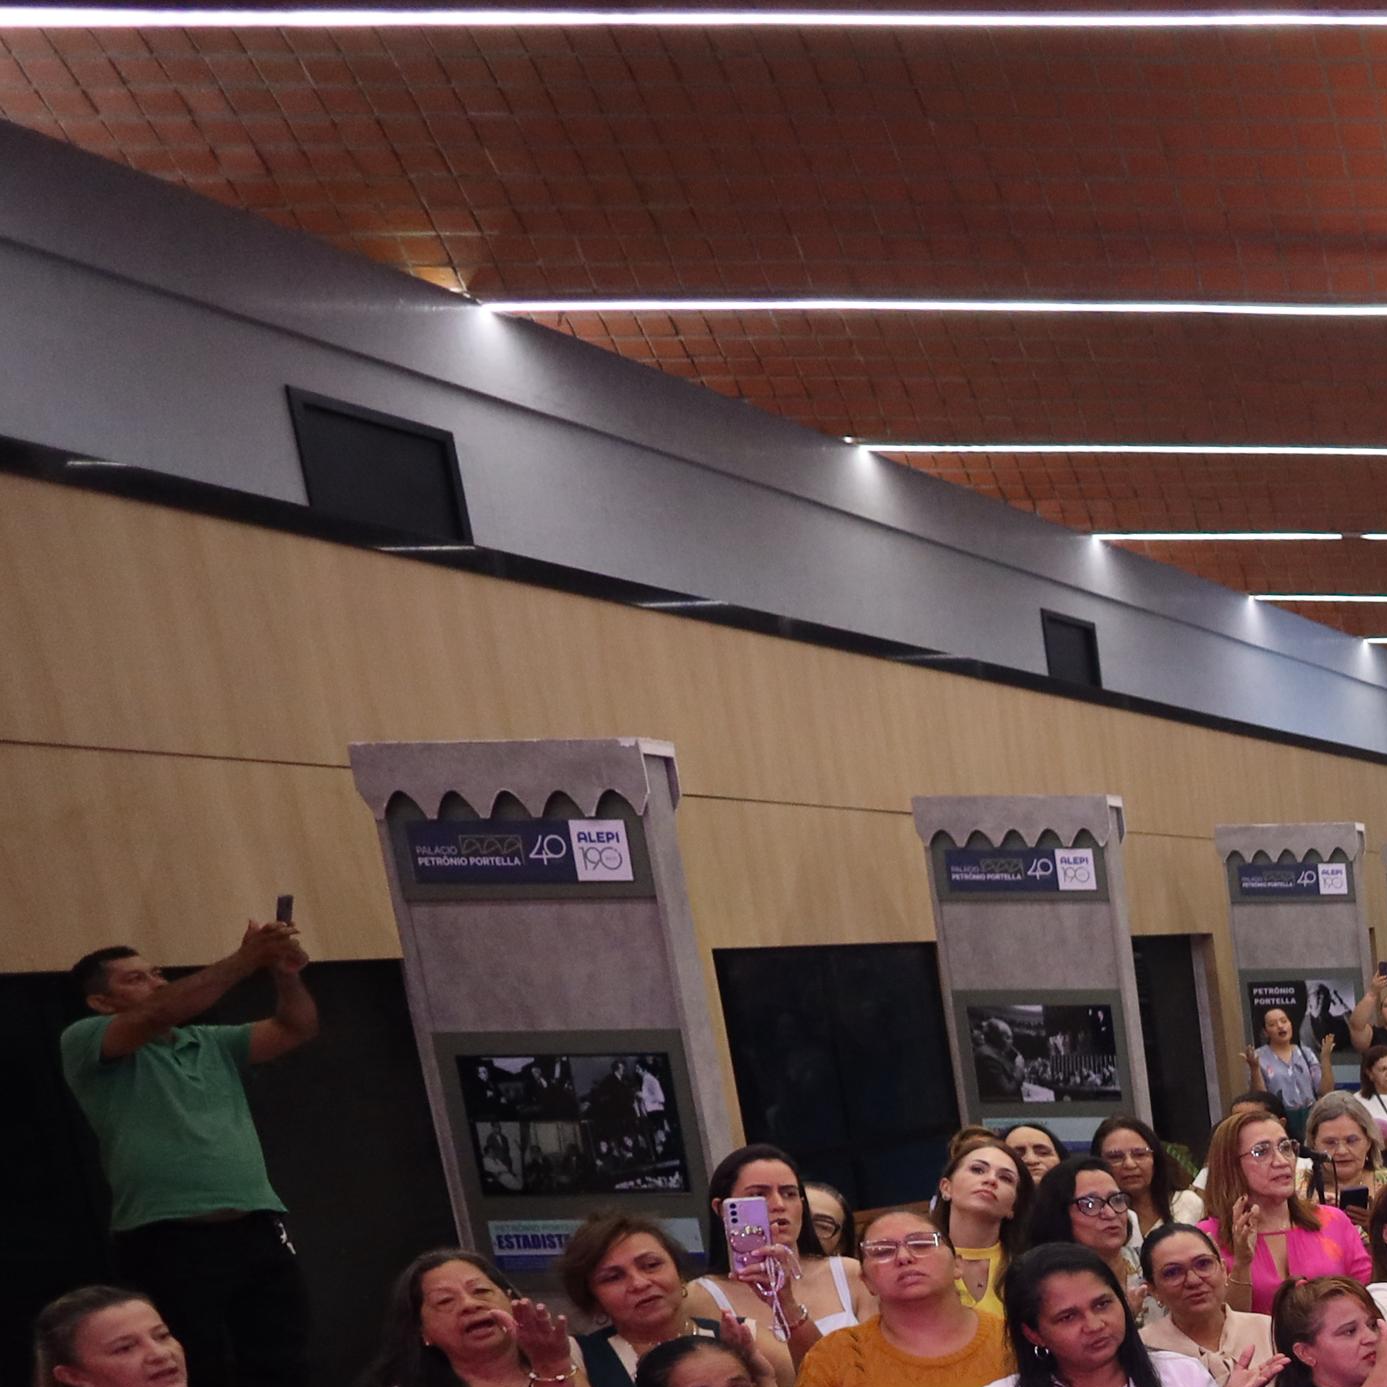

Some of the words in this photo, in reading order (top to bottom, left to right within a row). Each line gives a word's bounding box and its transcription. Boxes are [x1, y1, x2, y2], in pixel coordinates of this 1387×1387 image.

[577, 831, 620, 844] ALEPI
[529, 834, 566, 865] 40
[417, 853, 468, 866] PETRÔNIO
[469, 856, 522, 866] PORTELLA
[578, 846, 623, 871] 190
[1060, 856, 1089, 865] ALEPI
[1027, 858, 1053, 880] 40
[1297, 870, 1317, 887] 40
[1253, 986, 1295, 995] PETRÔNIO
[1254, 998, 1296, 1006] PORTELLA
